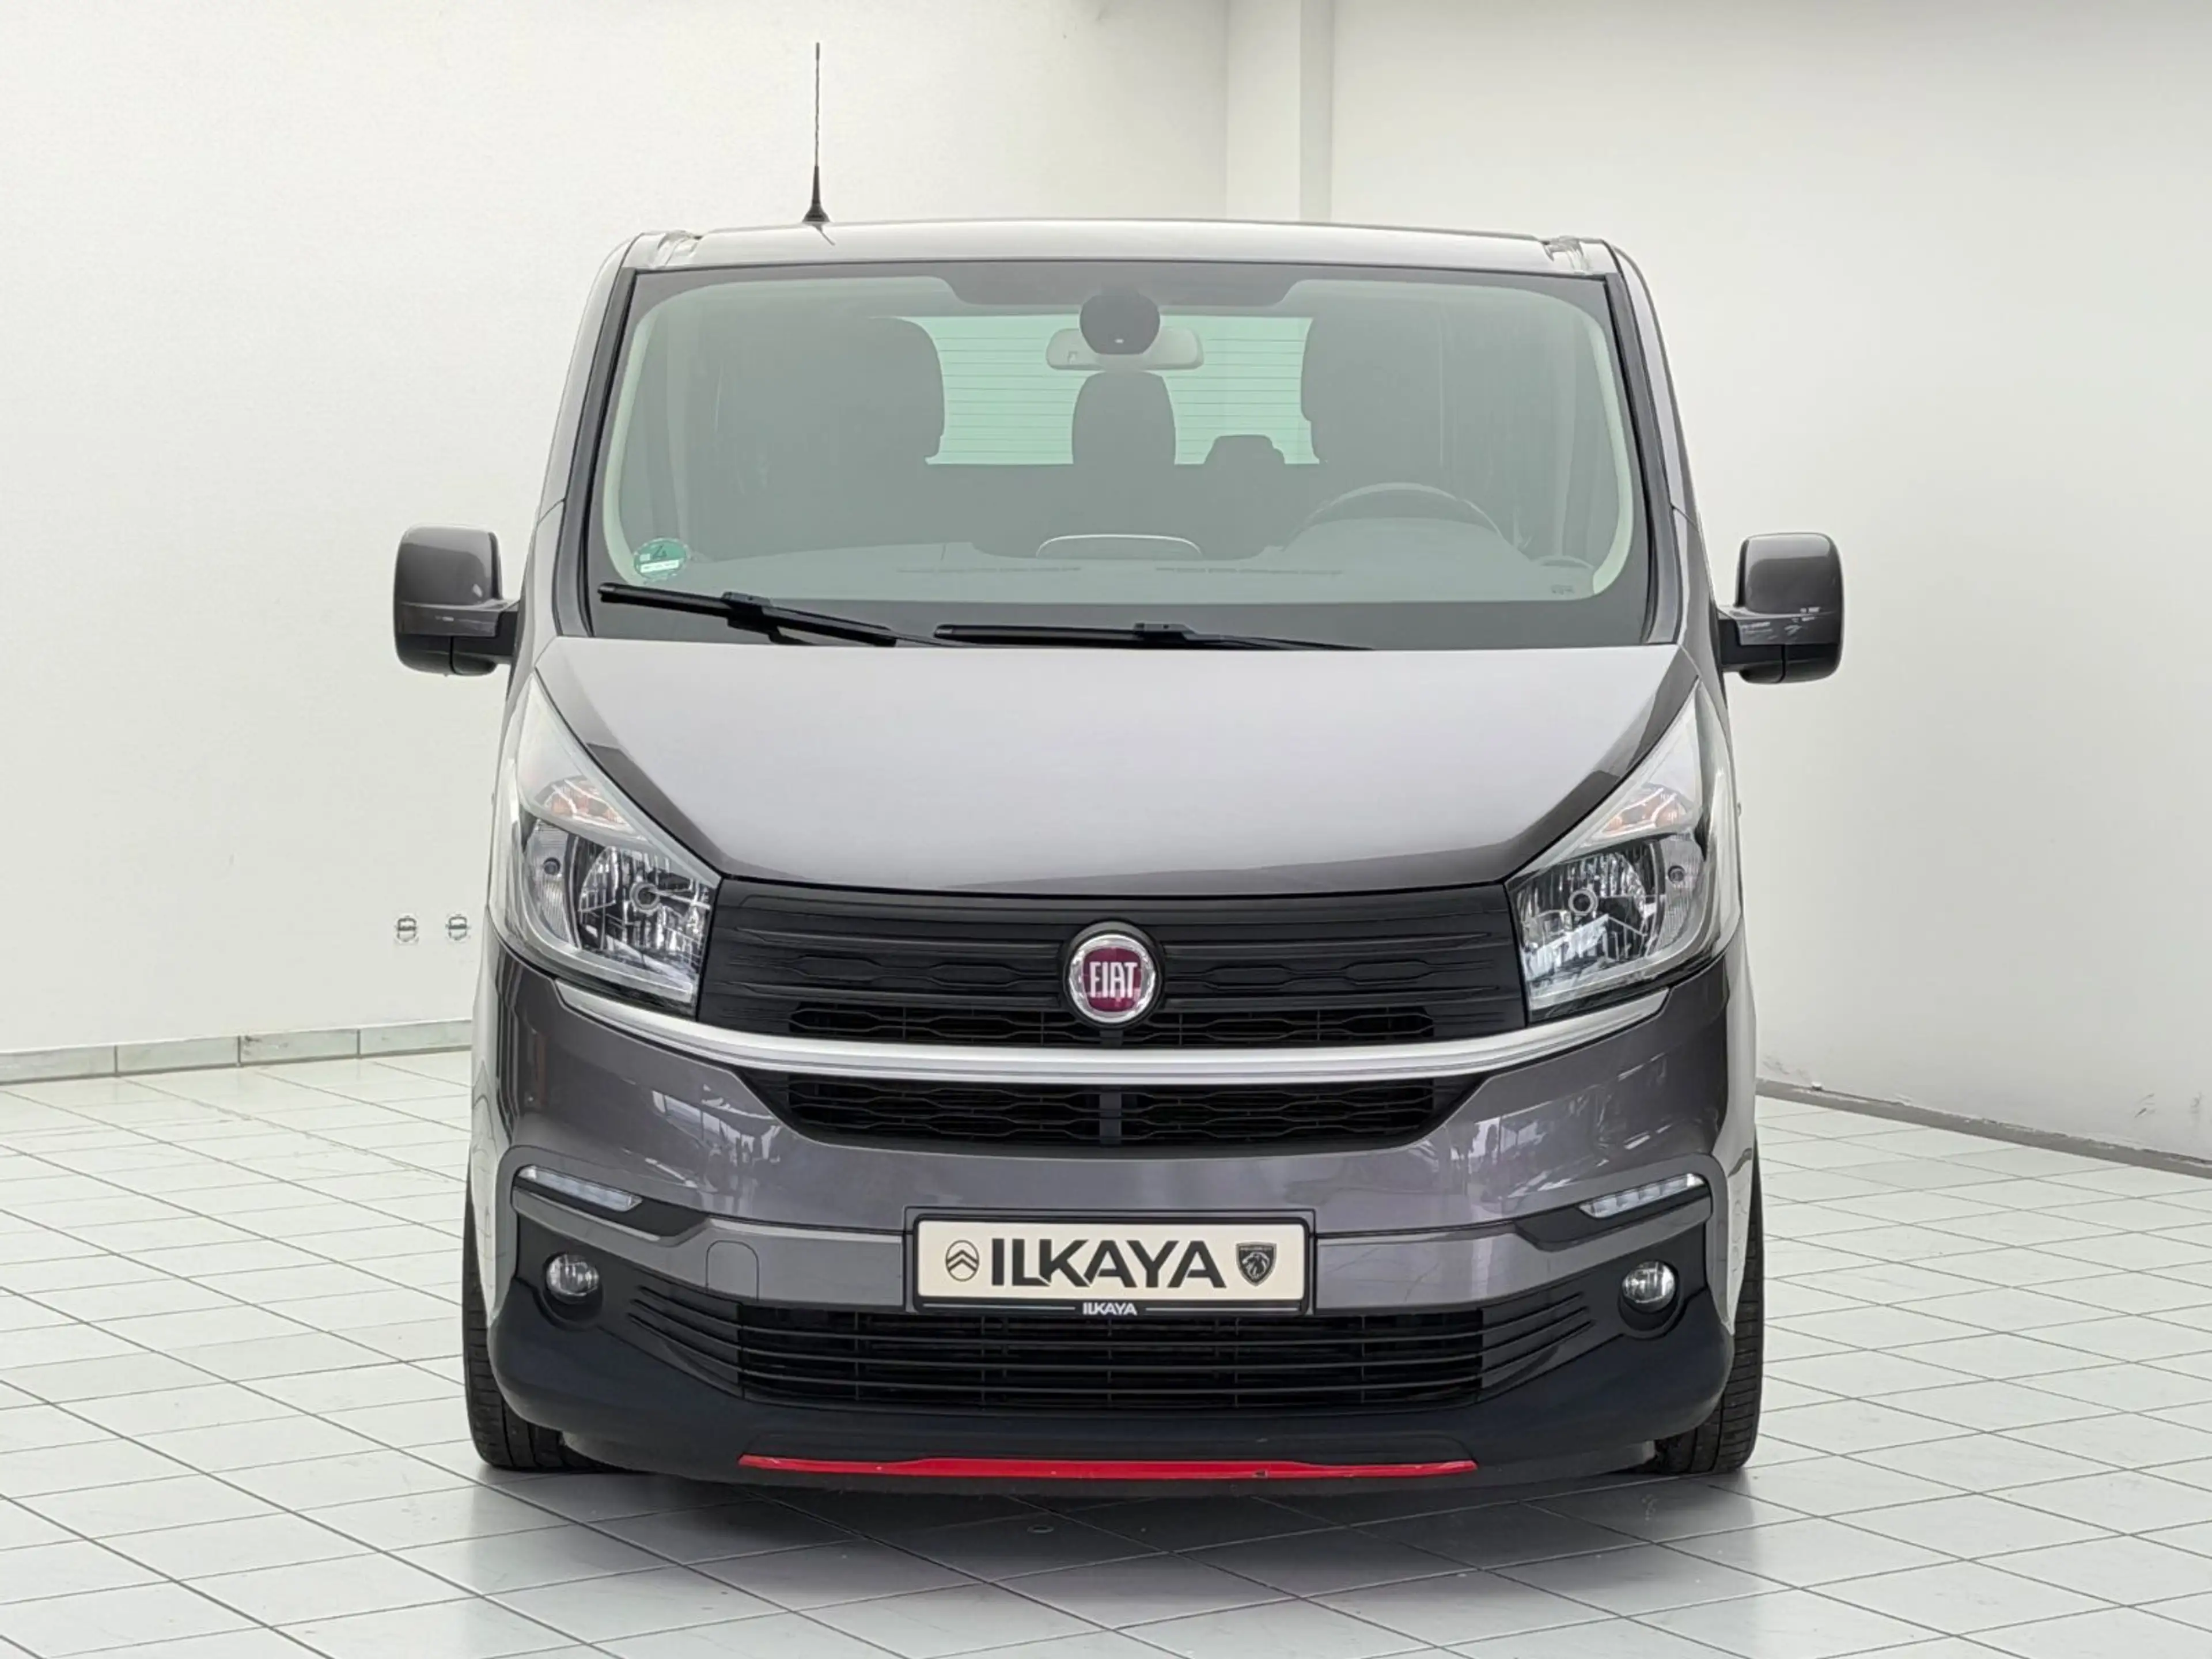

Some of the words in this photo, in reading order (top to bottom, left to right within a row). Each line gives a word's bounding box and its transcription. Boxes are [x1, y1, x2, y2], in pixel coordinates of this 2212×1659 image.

[1089, 961, 1138, 998] FIAT
[991, 1238, 1227, 1288] ILKAYA
[1082, 1302, 1138, 1316] ILKAYA
